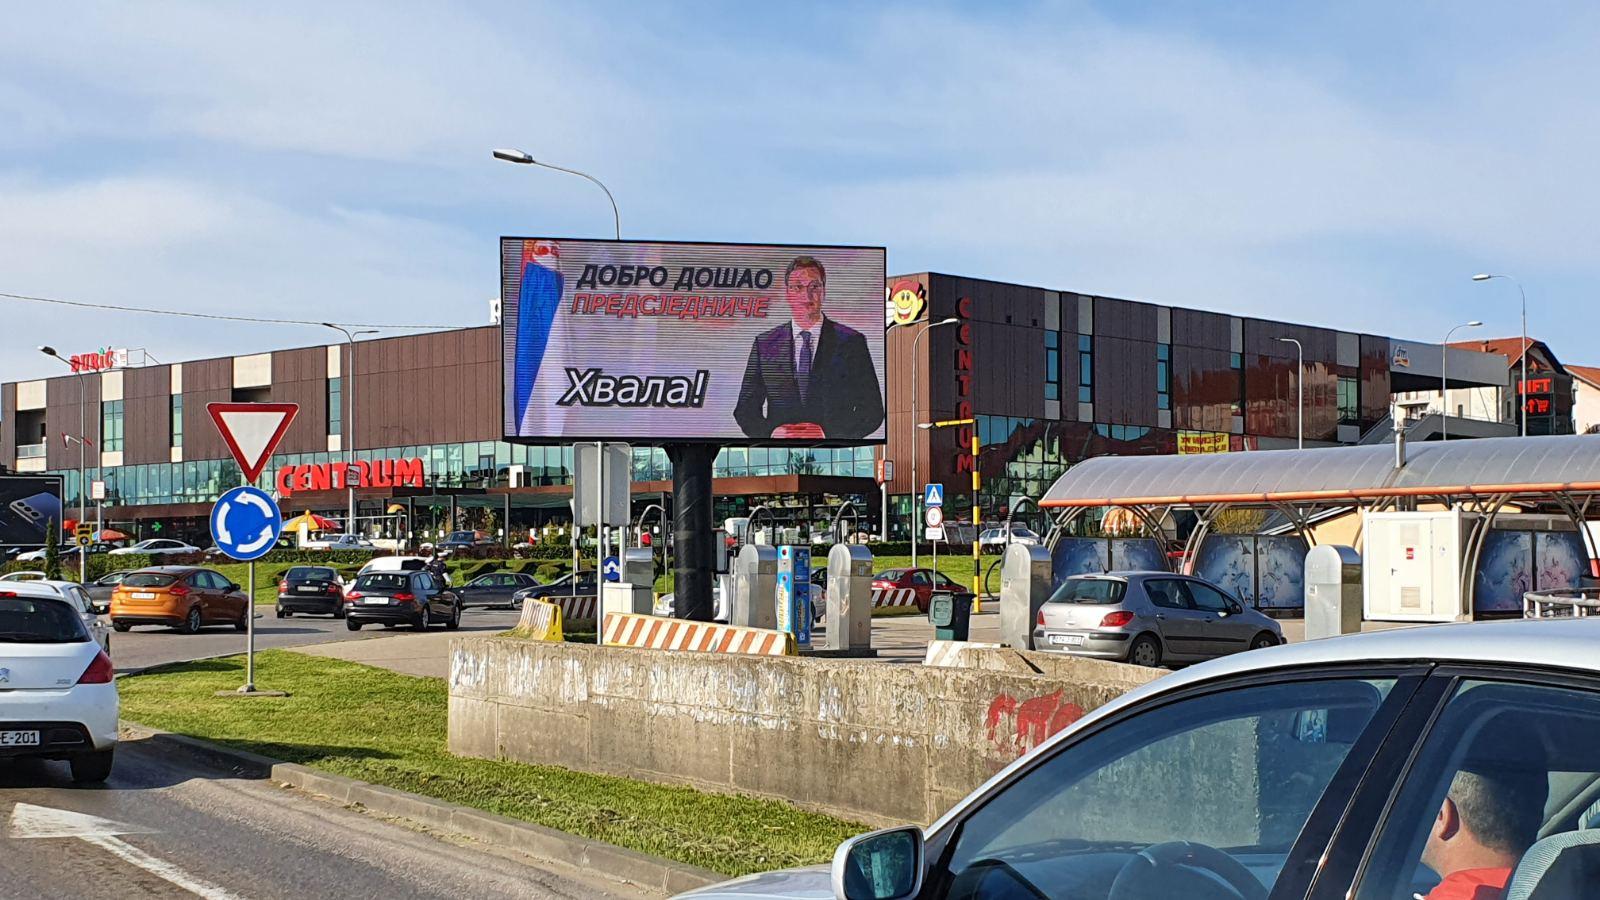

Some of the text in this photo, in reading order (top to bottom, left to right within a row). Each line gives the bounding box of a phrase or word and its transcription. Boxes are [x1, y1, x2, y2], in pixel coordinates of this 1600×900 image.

[576, 264, 773, 291] ДОБРО ДОШАО
[572, 293, 769, 318] ПРЕДСЈЕДНИЧЕ
[557, 368, 709, 408] Хвала!
[277, 457, 424, 497] CENTRUM
